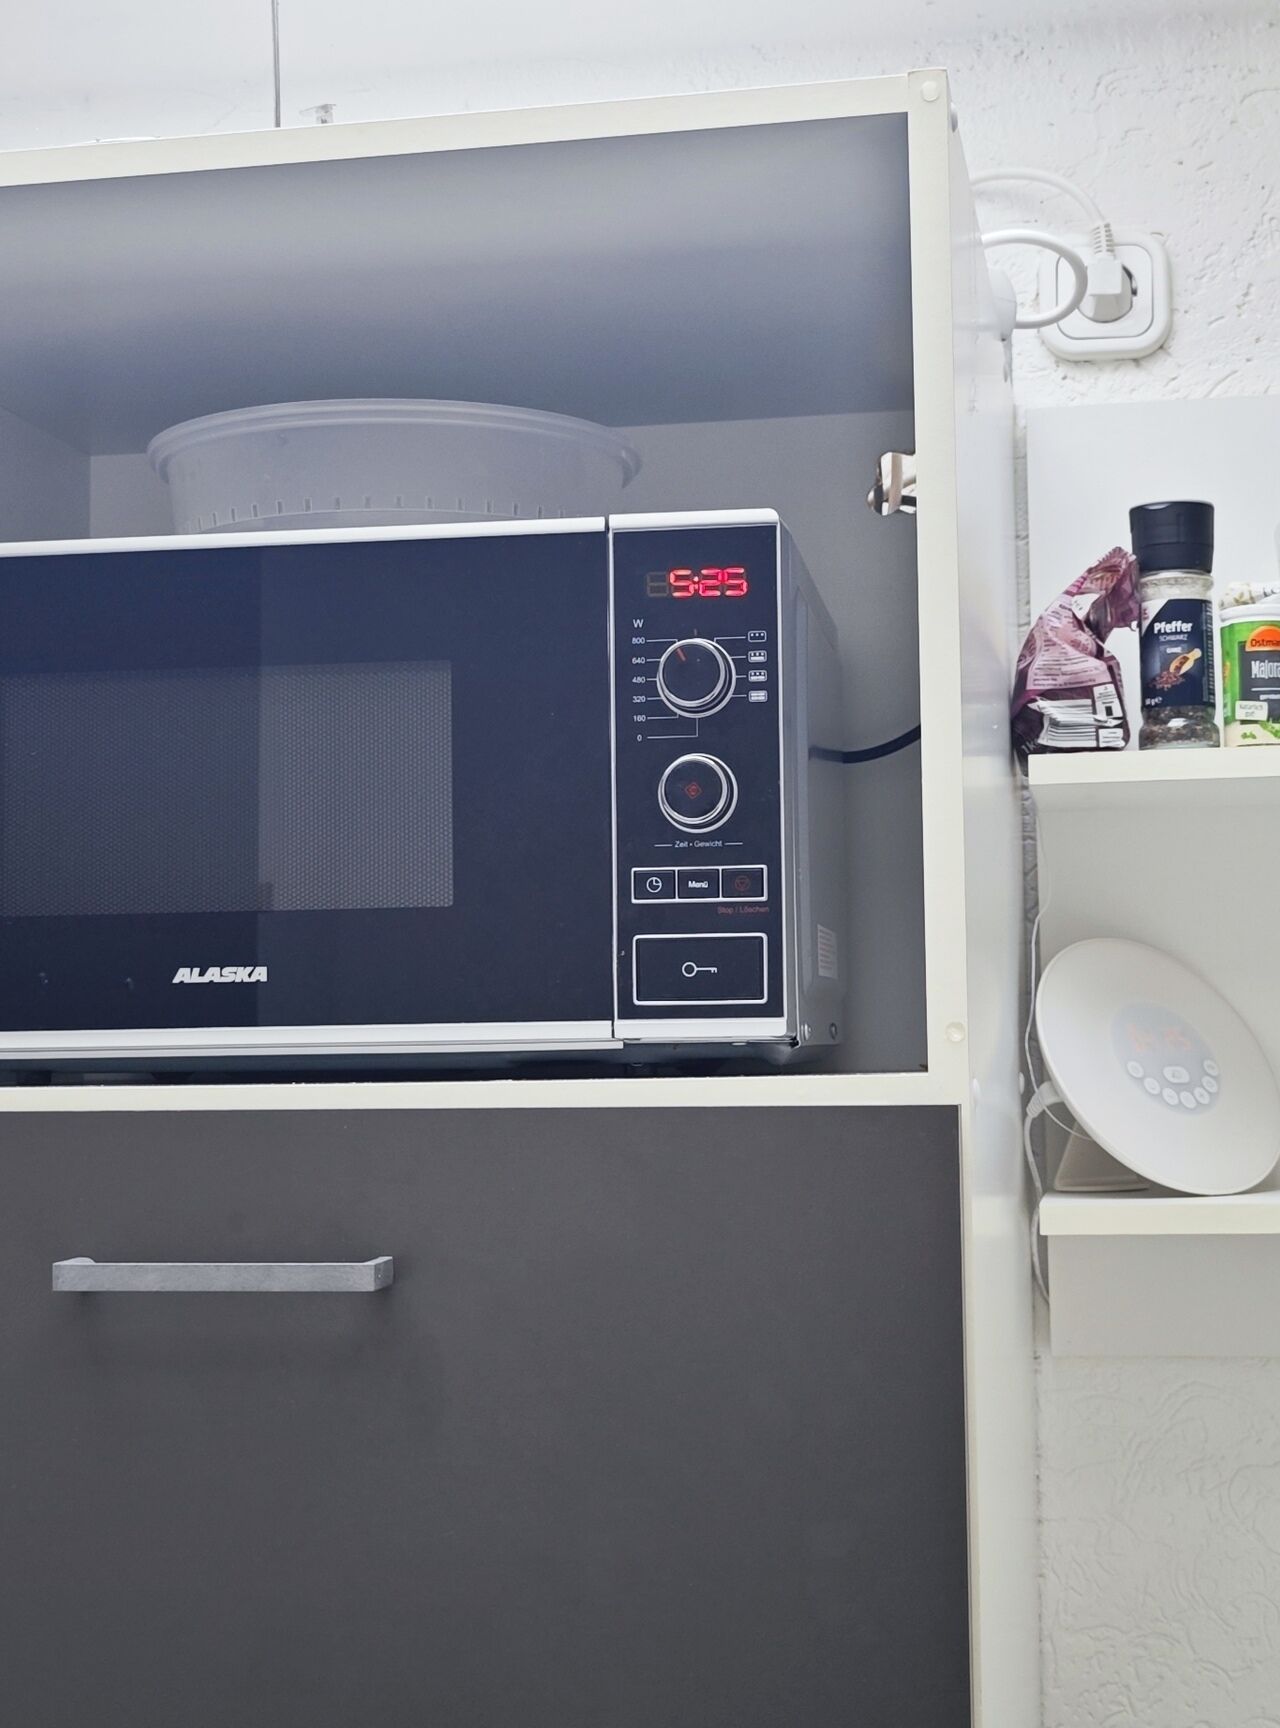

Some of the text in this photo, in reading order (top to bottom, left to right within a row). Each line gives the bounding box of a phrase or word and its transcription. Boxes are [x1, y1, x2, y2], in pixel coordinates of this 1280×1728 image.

[670, 567, 748, 598] 5:25
[633, 619, 644, 628] W
[1153, 621, 1193, 634] Pfeffer
[631, 637, 646, 645] 800
[631, 656, 646, 664] 640
[631, 675, 646, 684] 480
[632, 694, 646, 703] 320
[632, 714, 646, 722] 160
[636, 734, 643, 742] 0
[694, 840, 723, 848] Gewicht
[688, 880, 709, 888] Menü
[717, 906, 734, 914] Stop
[739, 905, 770, 913] Löschen
[172, 966, 268, 984] ALASKA
